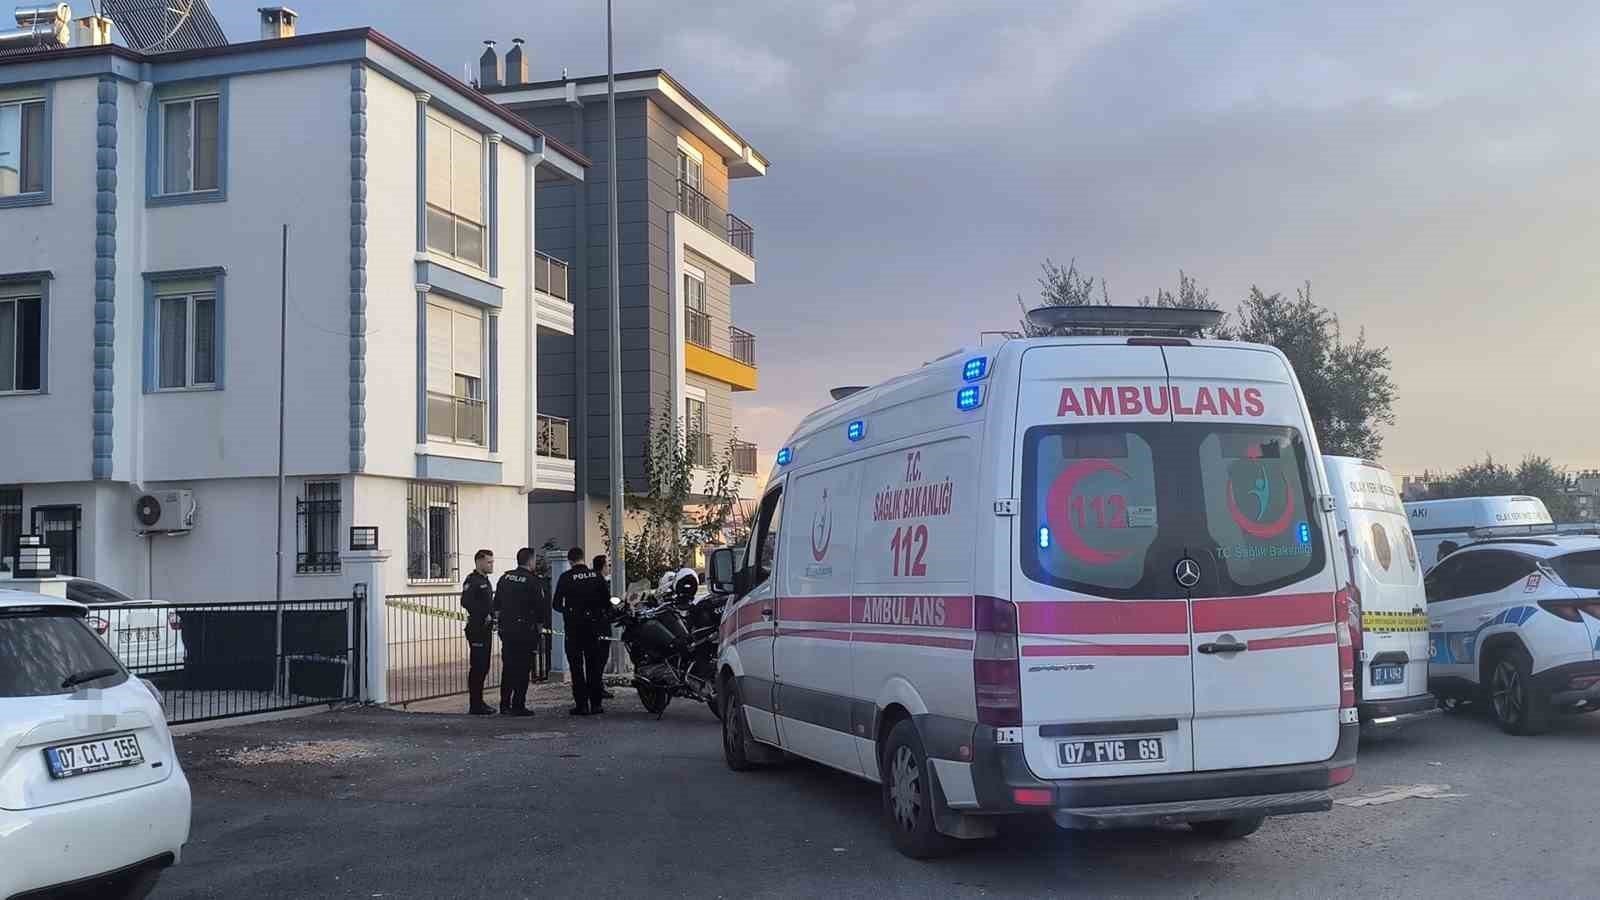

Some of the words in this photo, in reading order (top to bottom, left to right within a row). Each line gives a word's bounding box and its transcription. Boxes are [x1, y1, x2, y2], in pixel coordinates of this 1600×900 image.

[1057, 386, 1264, 417] AMBULANS
[905, 451, 922, 483] T.C.
[873, 484, 902, 522] SAĞLIK
[903, 475, 953, 519] BAKANLIĞI
[1071, 495, 1128, 528] 112
[890, 524, 928, 577] 112
[862, 597, 945, 626] AMBULANS
[58, 748, 76, 768] 07
[81, 743, 110, 764] CCJ
[114, 738, 139, 759] 155
[1064, 743, 1085, 763] 07
[1094, 741, 1126, 762] FVG
[1138, 740, 1159, 760] 69
